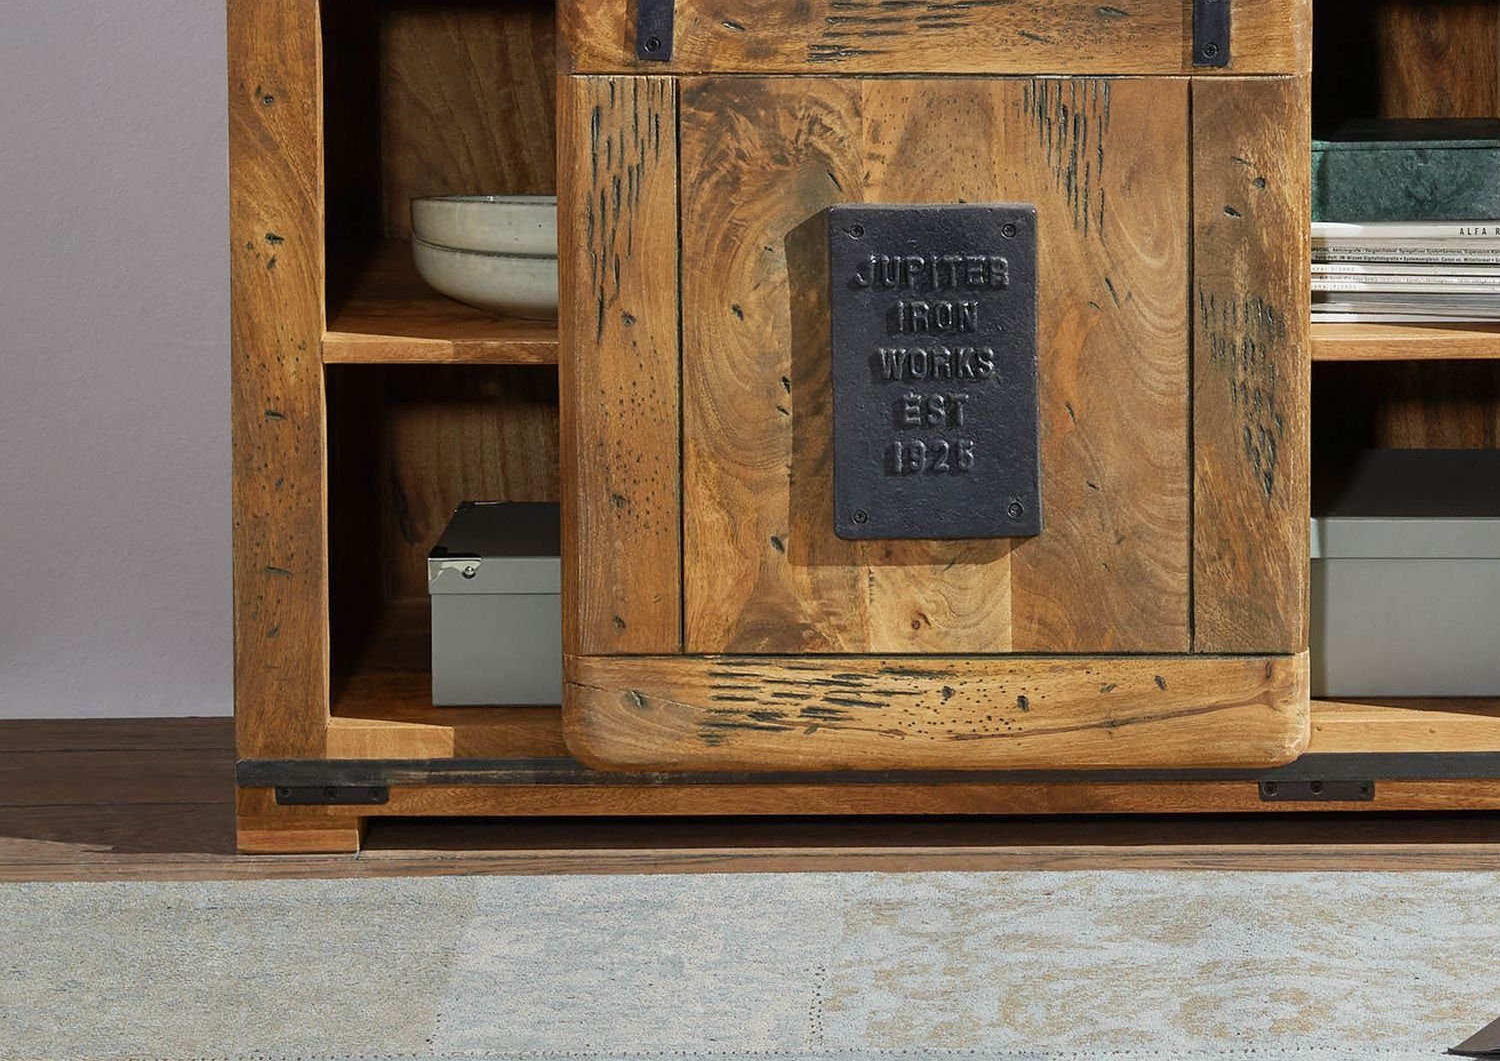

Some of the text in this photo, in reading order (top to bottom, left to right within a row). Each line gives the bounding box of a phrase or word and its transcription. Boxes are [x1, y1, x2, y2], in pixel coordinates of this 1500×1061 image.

[1459, 227, 1487, 236] ALFA
[855, 254, 1011, 289] JUPITER
[895, 300, 979, 333] IRON
[874, 346, 996, 381] WORKS
[901, 392, 970, 426] EST
